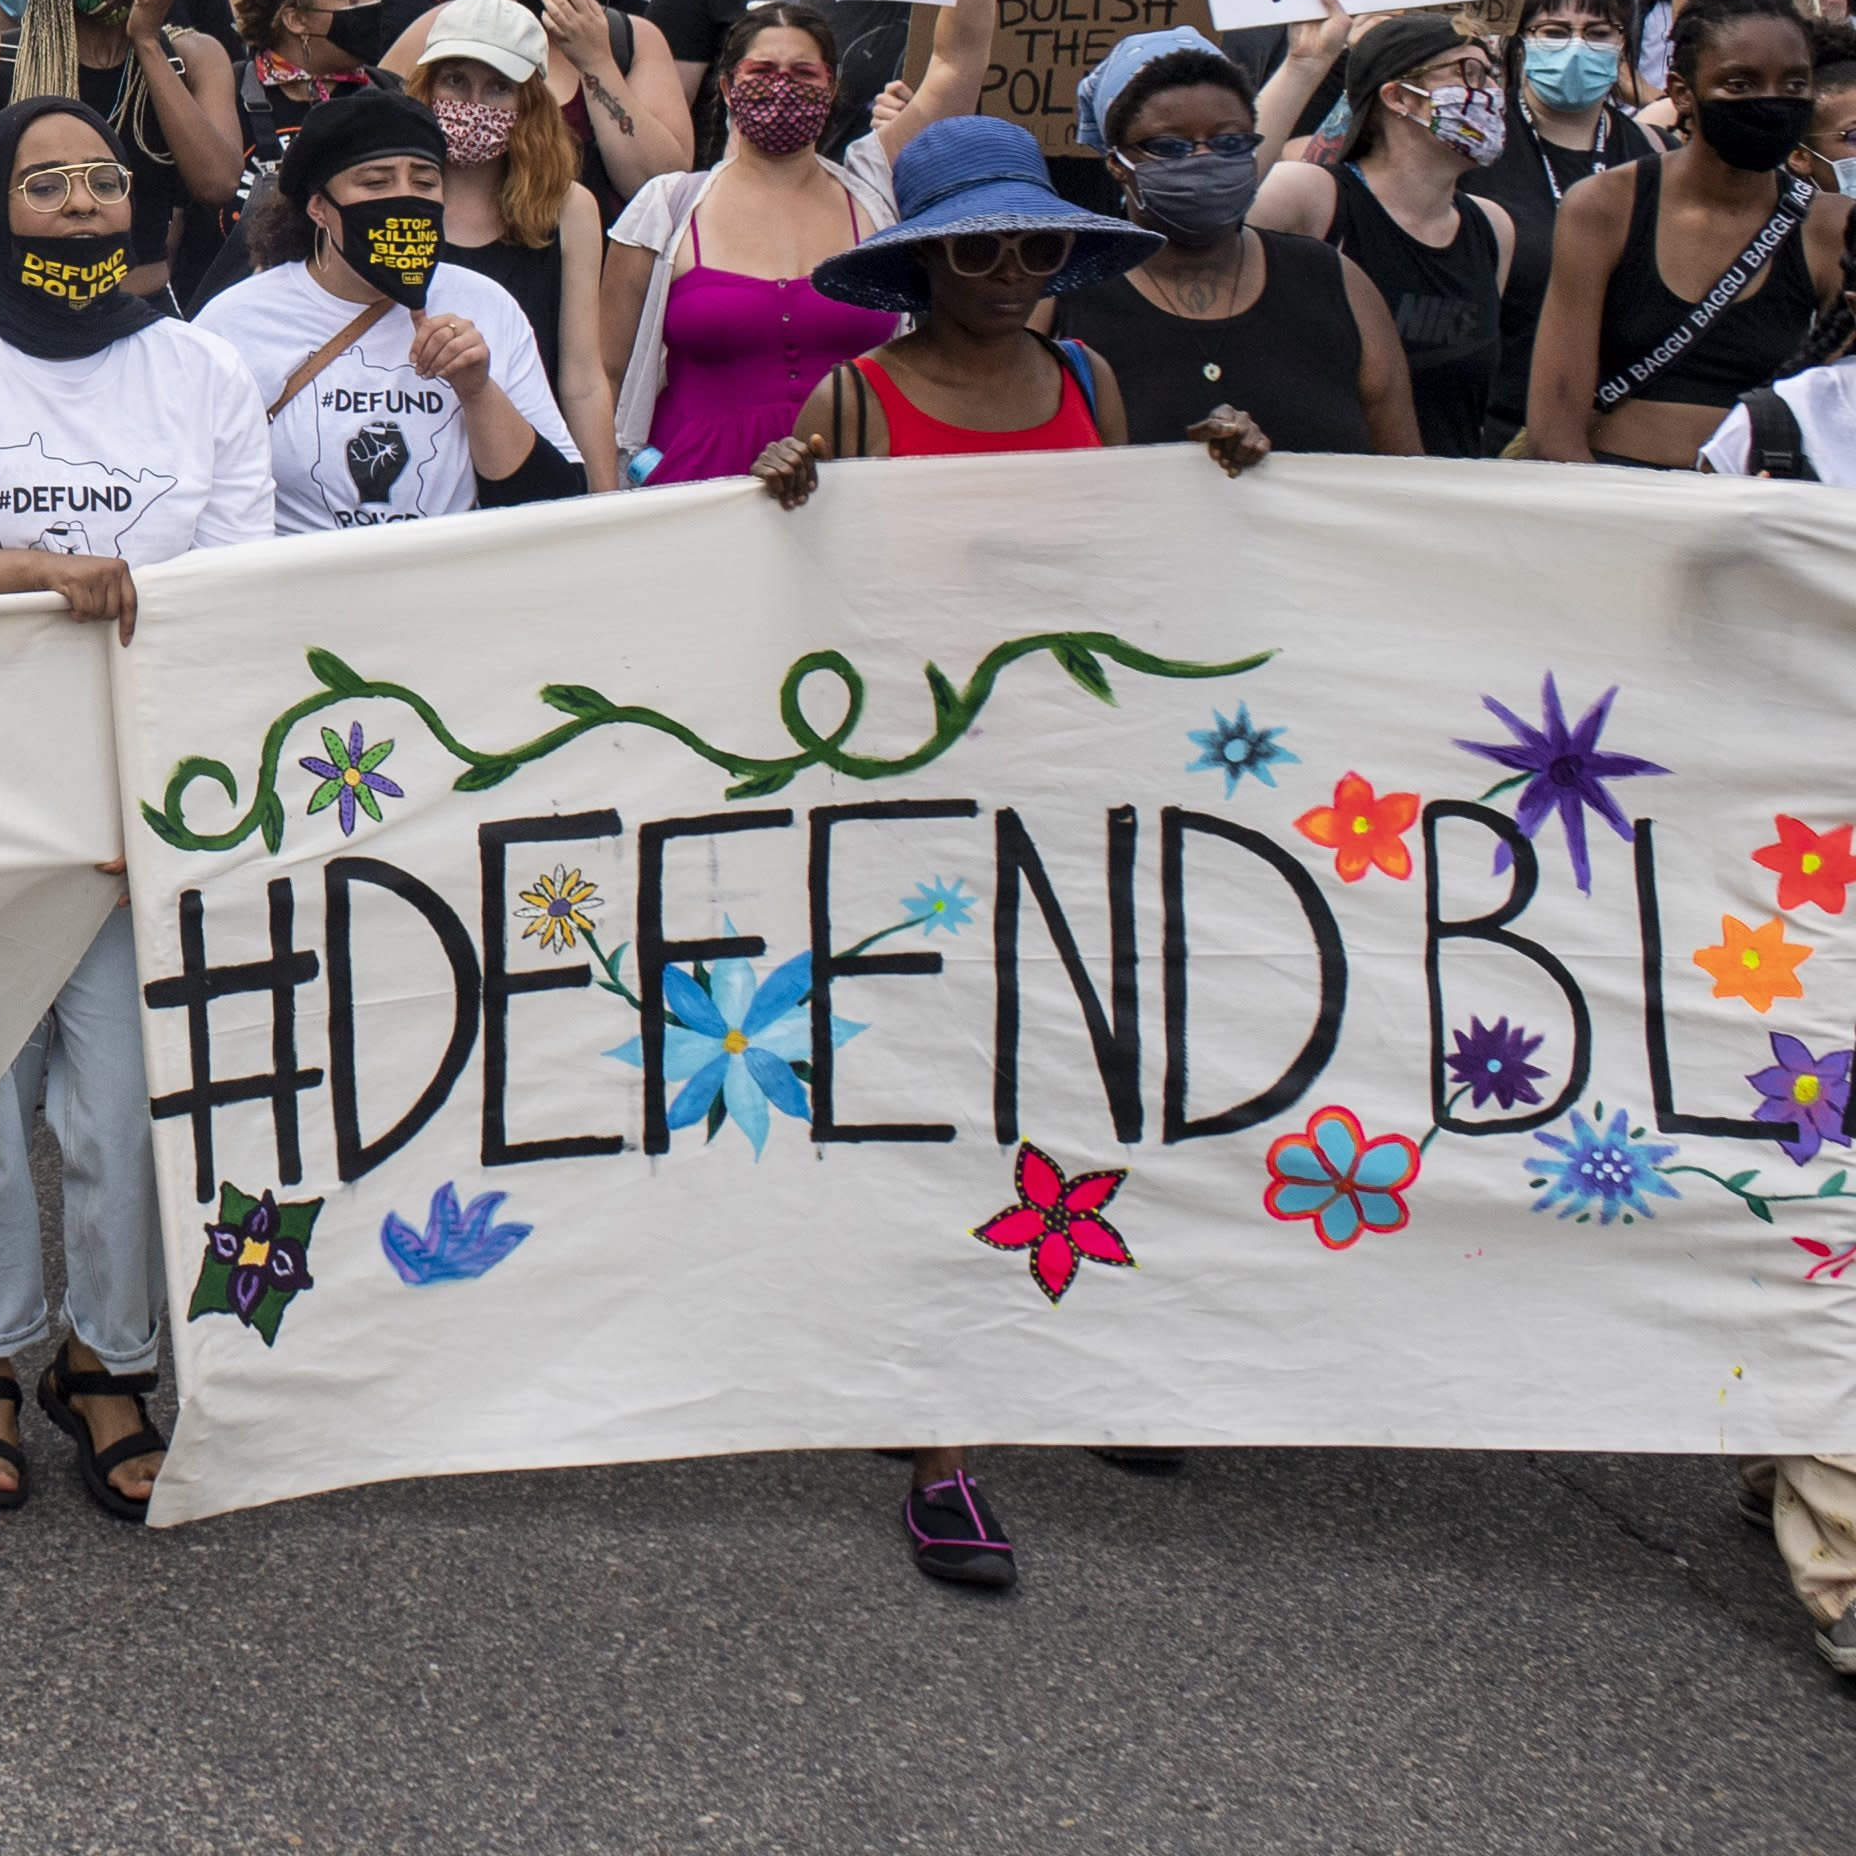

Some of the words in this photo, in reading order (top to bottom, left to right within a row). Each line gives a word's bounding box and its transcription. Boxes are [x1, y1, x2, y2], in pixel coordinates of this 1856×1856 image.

[1014, 28, 1116, 67] THE
[368, 229, 438, 243] KILLING
[384, 218, 432, 231] STOP
[23, 247, 126, 283] DEFUND
[373, 243, 436, 256] BLACK
[21, 263, 128, 301] POLICE
[1690, 266, 1748, 327] BAGGU
[1630, 324, 1692, 384] BAGGU
[320, 388, 444, 416] #DEFUND
